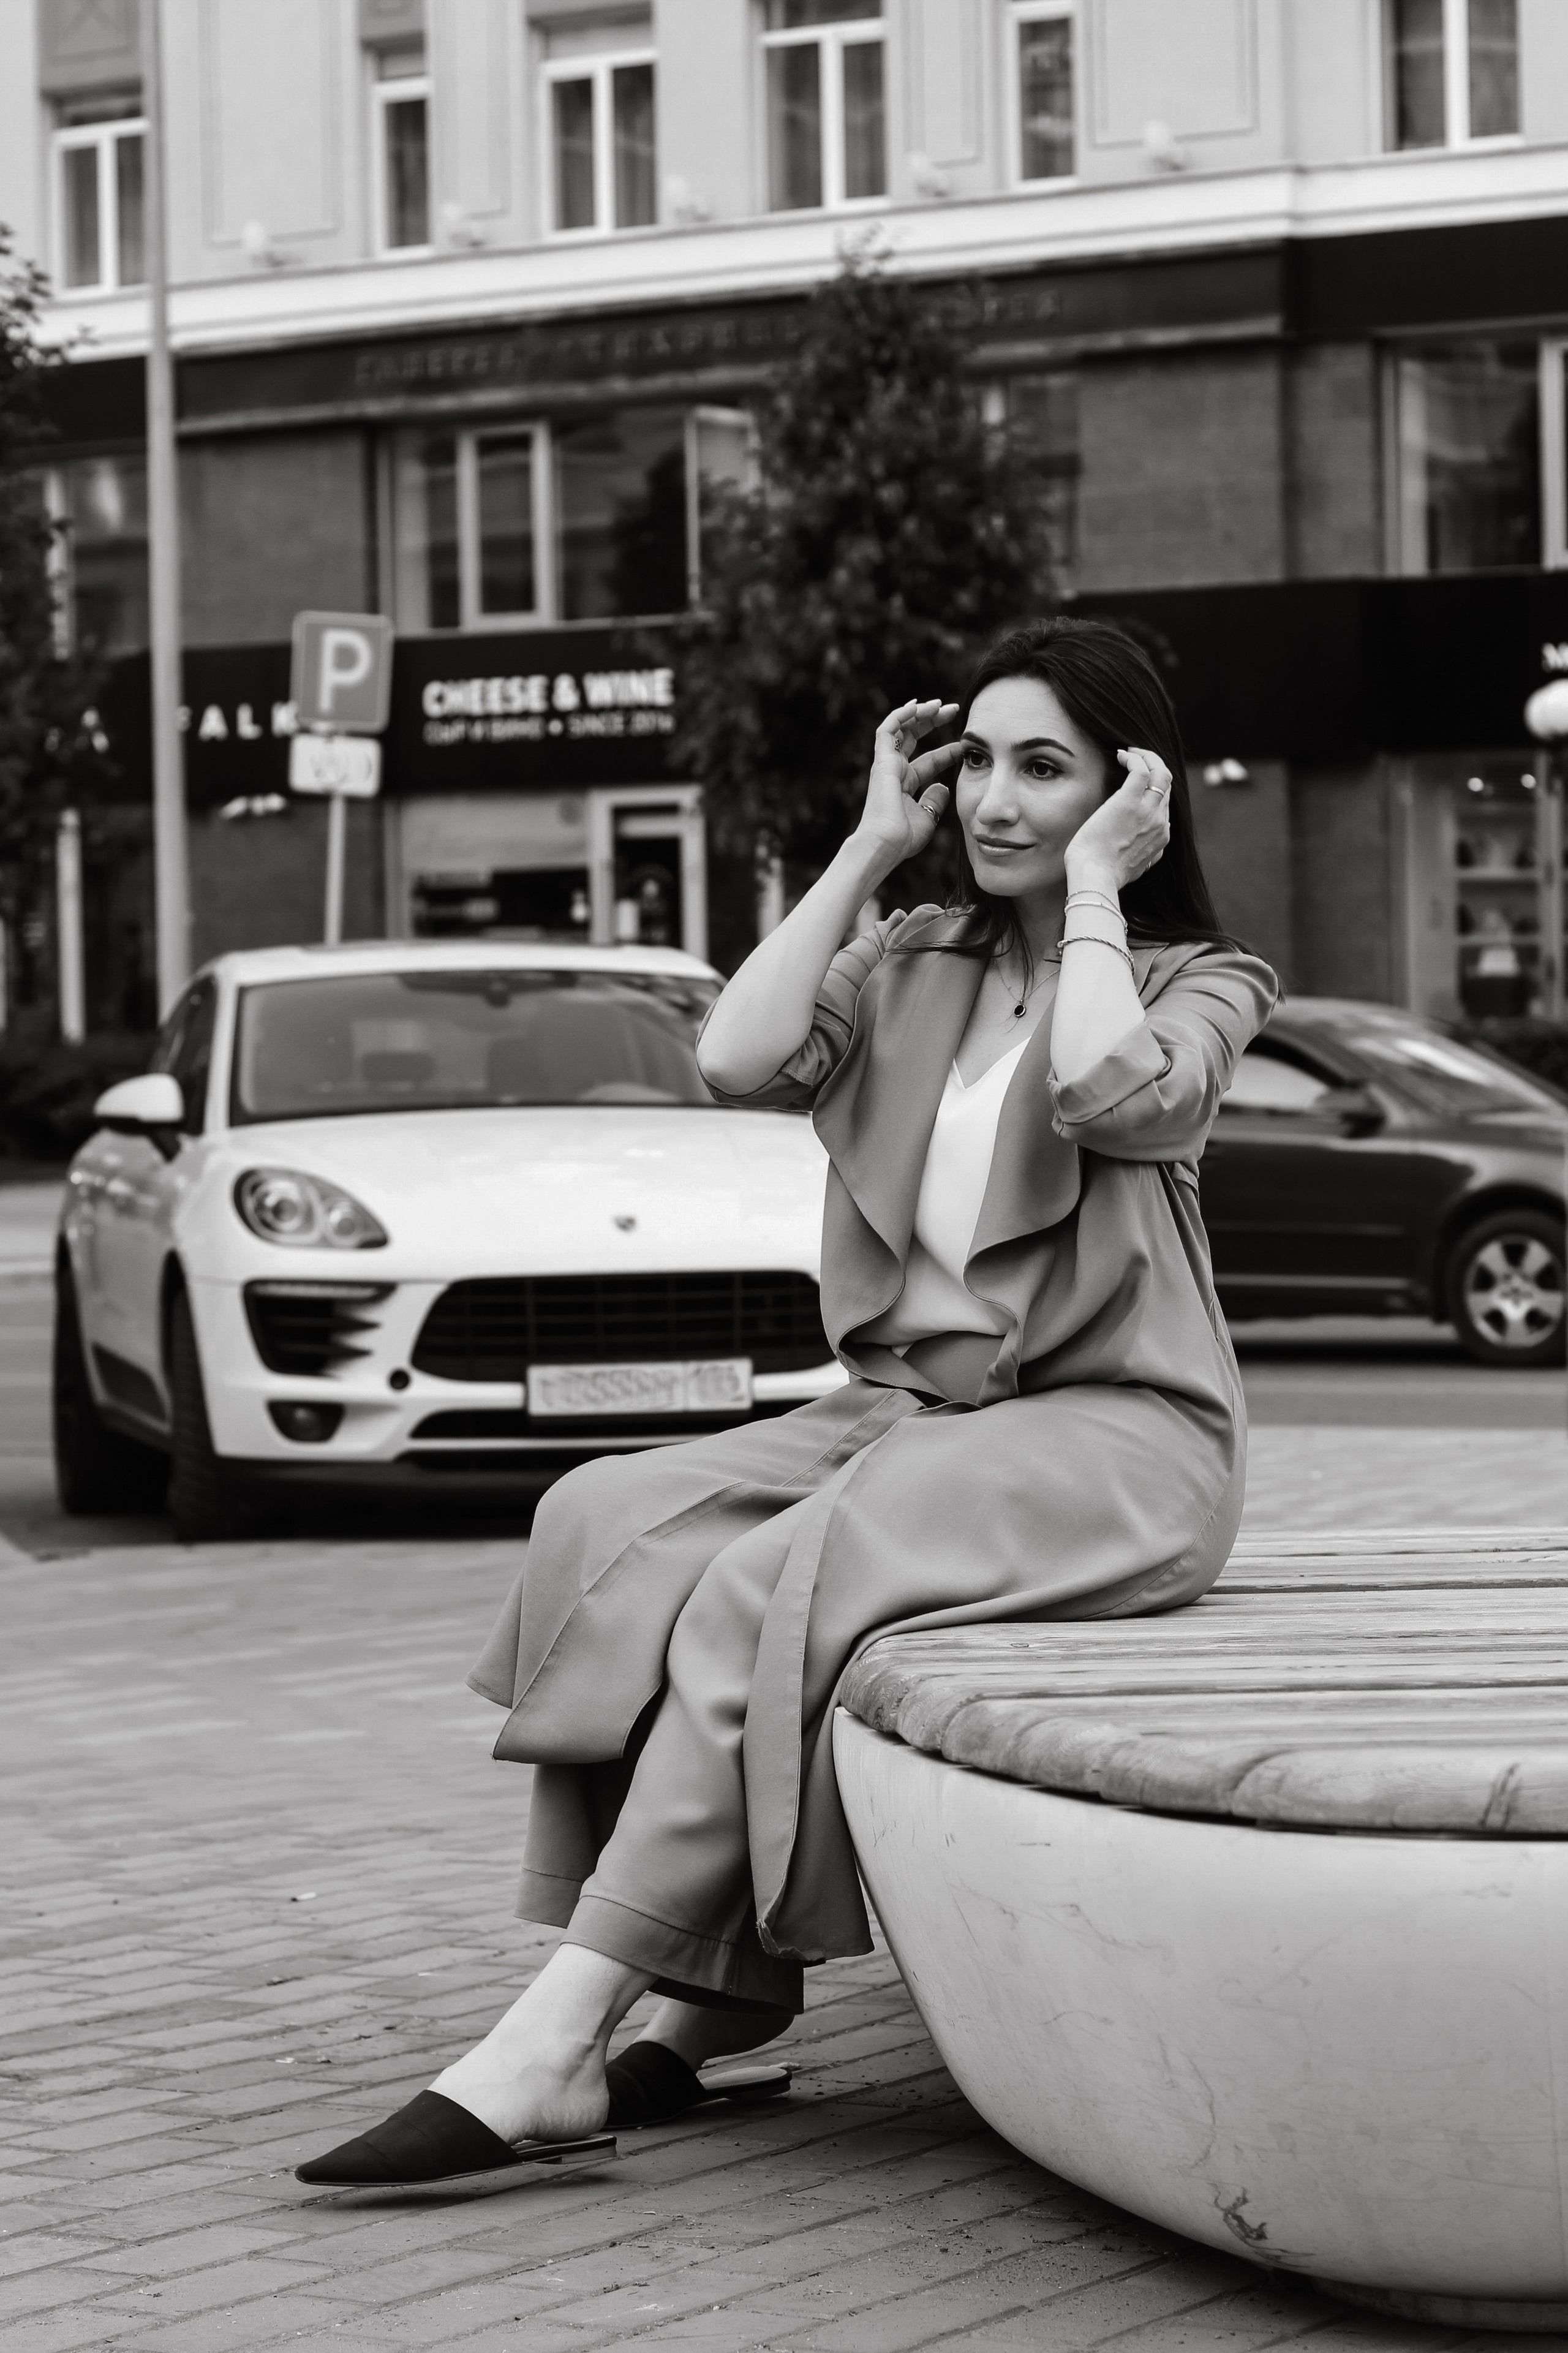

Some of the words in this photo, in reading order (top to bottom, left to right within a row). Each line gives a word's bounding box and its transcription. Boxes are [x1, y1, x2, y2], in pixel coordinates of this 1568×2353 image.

[320, 628, 371, 712] P
[424, 675, 549, 717] CHEESE
[552, 673, 580, 711] &
[583, 668, 674, 709] WINE
